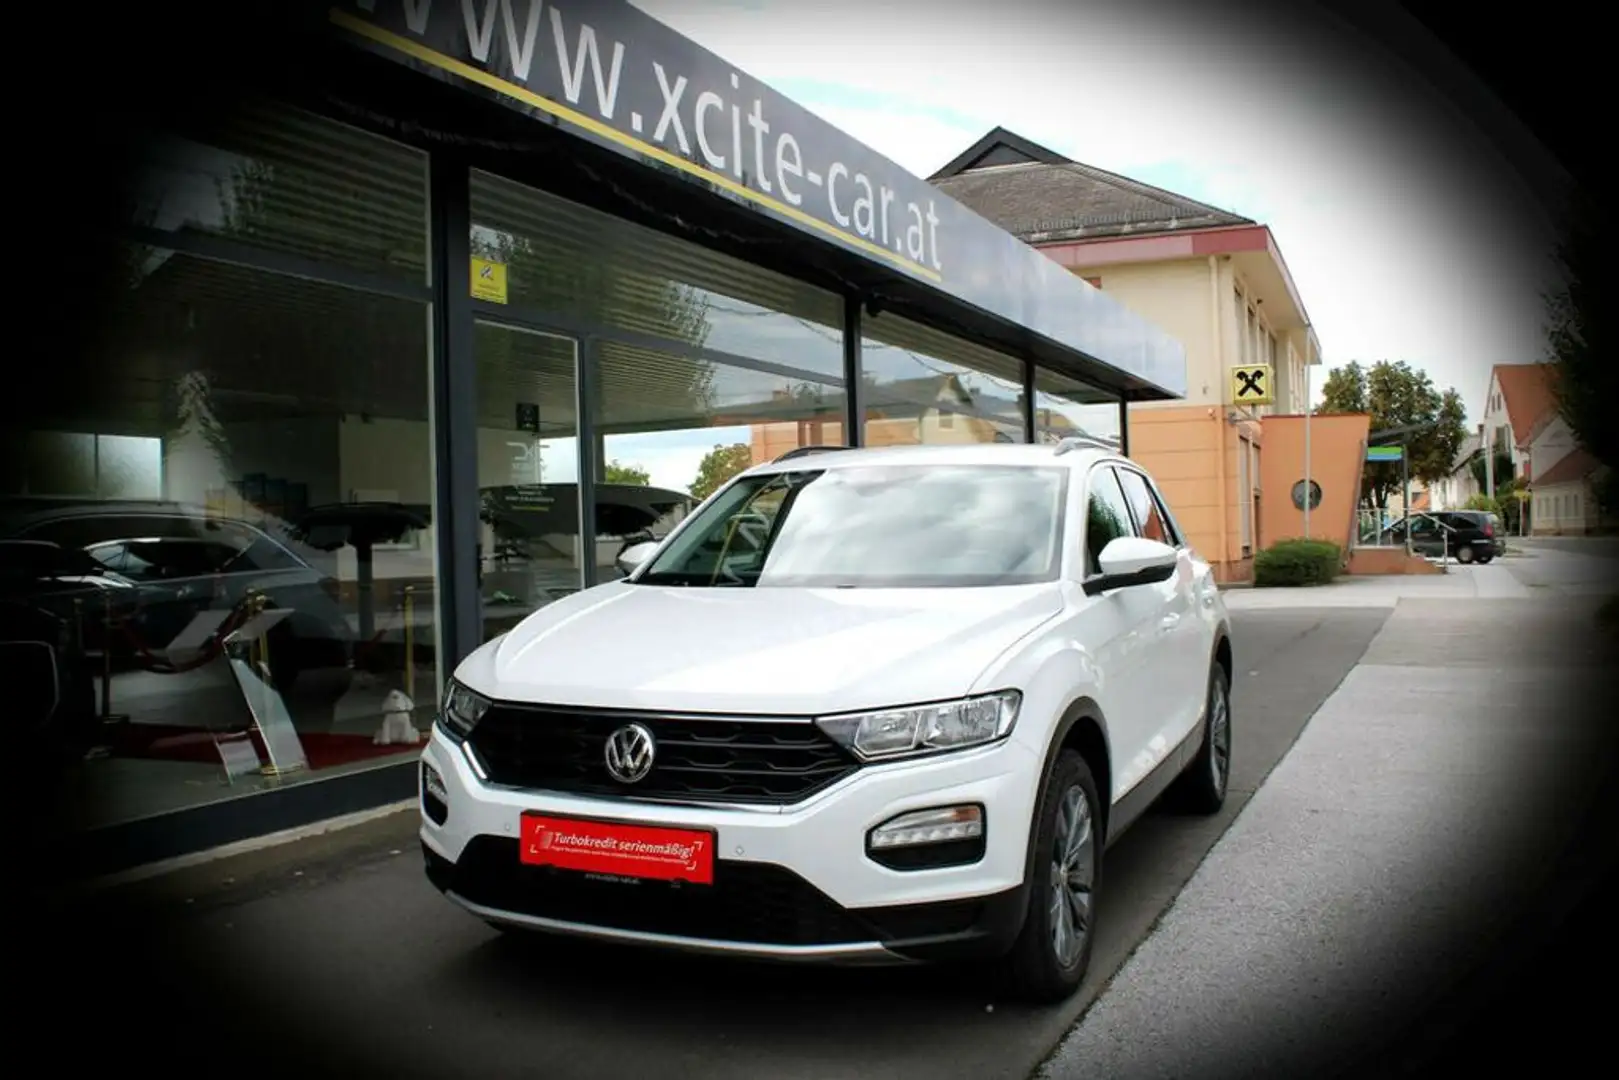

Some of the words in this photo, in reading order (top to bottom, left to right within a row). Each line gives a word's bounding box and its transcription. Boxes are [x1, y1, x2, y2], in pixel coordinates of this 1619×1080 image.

[353, 0, 942, 270] ww.xcite-car.at
[553, 831, 616, 850] Turbokredit
[618, 839, 694, 861] serienmäßig!
